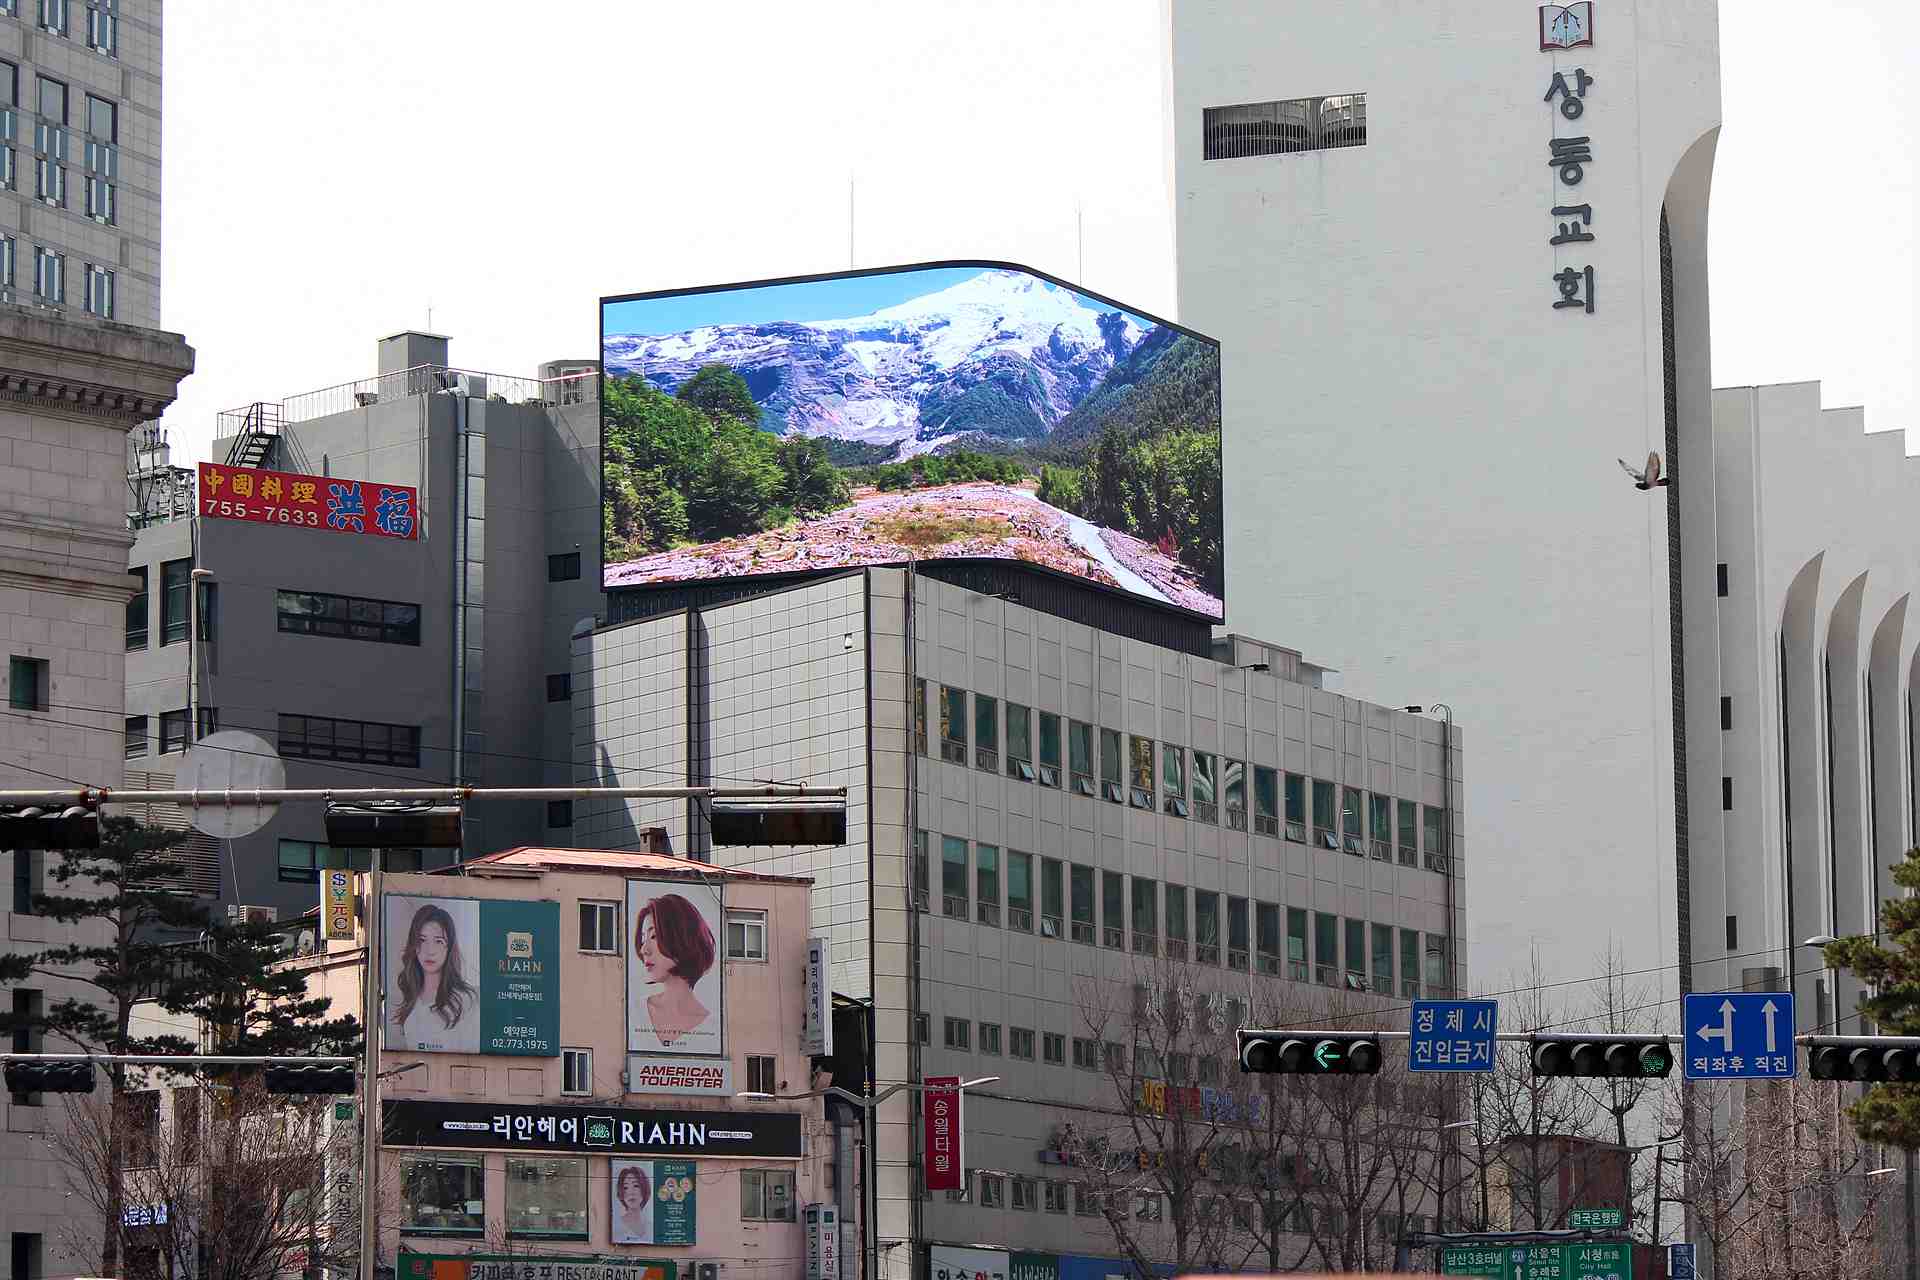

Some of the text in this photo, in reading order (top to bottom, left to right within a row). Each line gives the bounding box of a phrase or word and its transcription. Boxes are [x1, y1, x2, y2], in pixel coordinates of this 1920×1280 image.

[1543, 67, 1594, 314] 상동교회
[204, 468, 414, 538] 中國料理 洪福
[205, 499, 321, 526] 755-7633
[498, 960, 542, 973] RIAHN
[503, 1025, 538, 1038] 예약문의
[492, 1038, 548, 1050] 02.773.1975
[1415, 1039, 1490, 1064] 진입금지
[640, 1065, 724, 1078] AMERICAN
[1693, 1056, 1787, 1073] 직좌후 직진
[639, 1075, 723, 1089] TOURISTER
[493, 1115, 578, 1142] 리안헤어
[621, 1121, 705, 1146] RIAHN
[1528, 1247, 1560, 1259] 서울역
[1579, 1247, 1602, 1262] 시청
